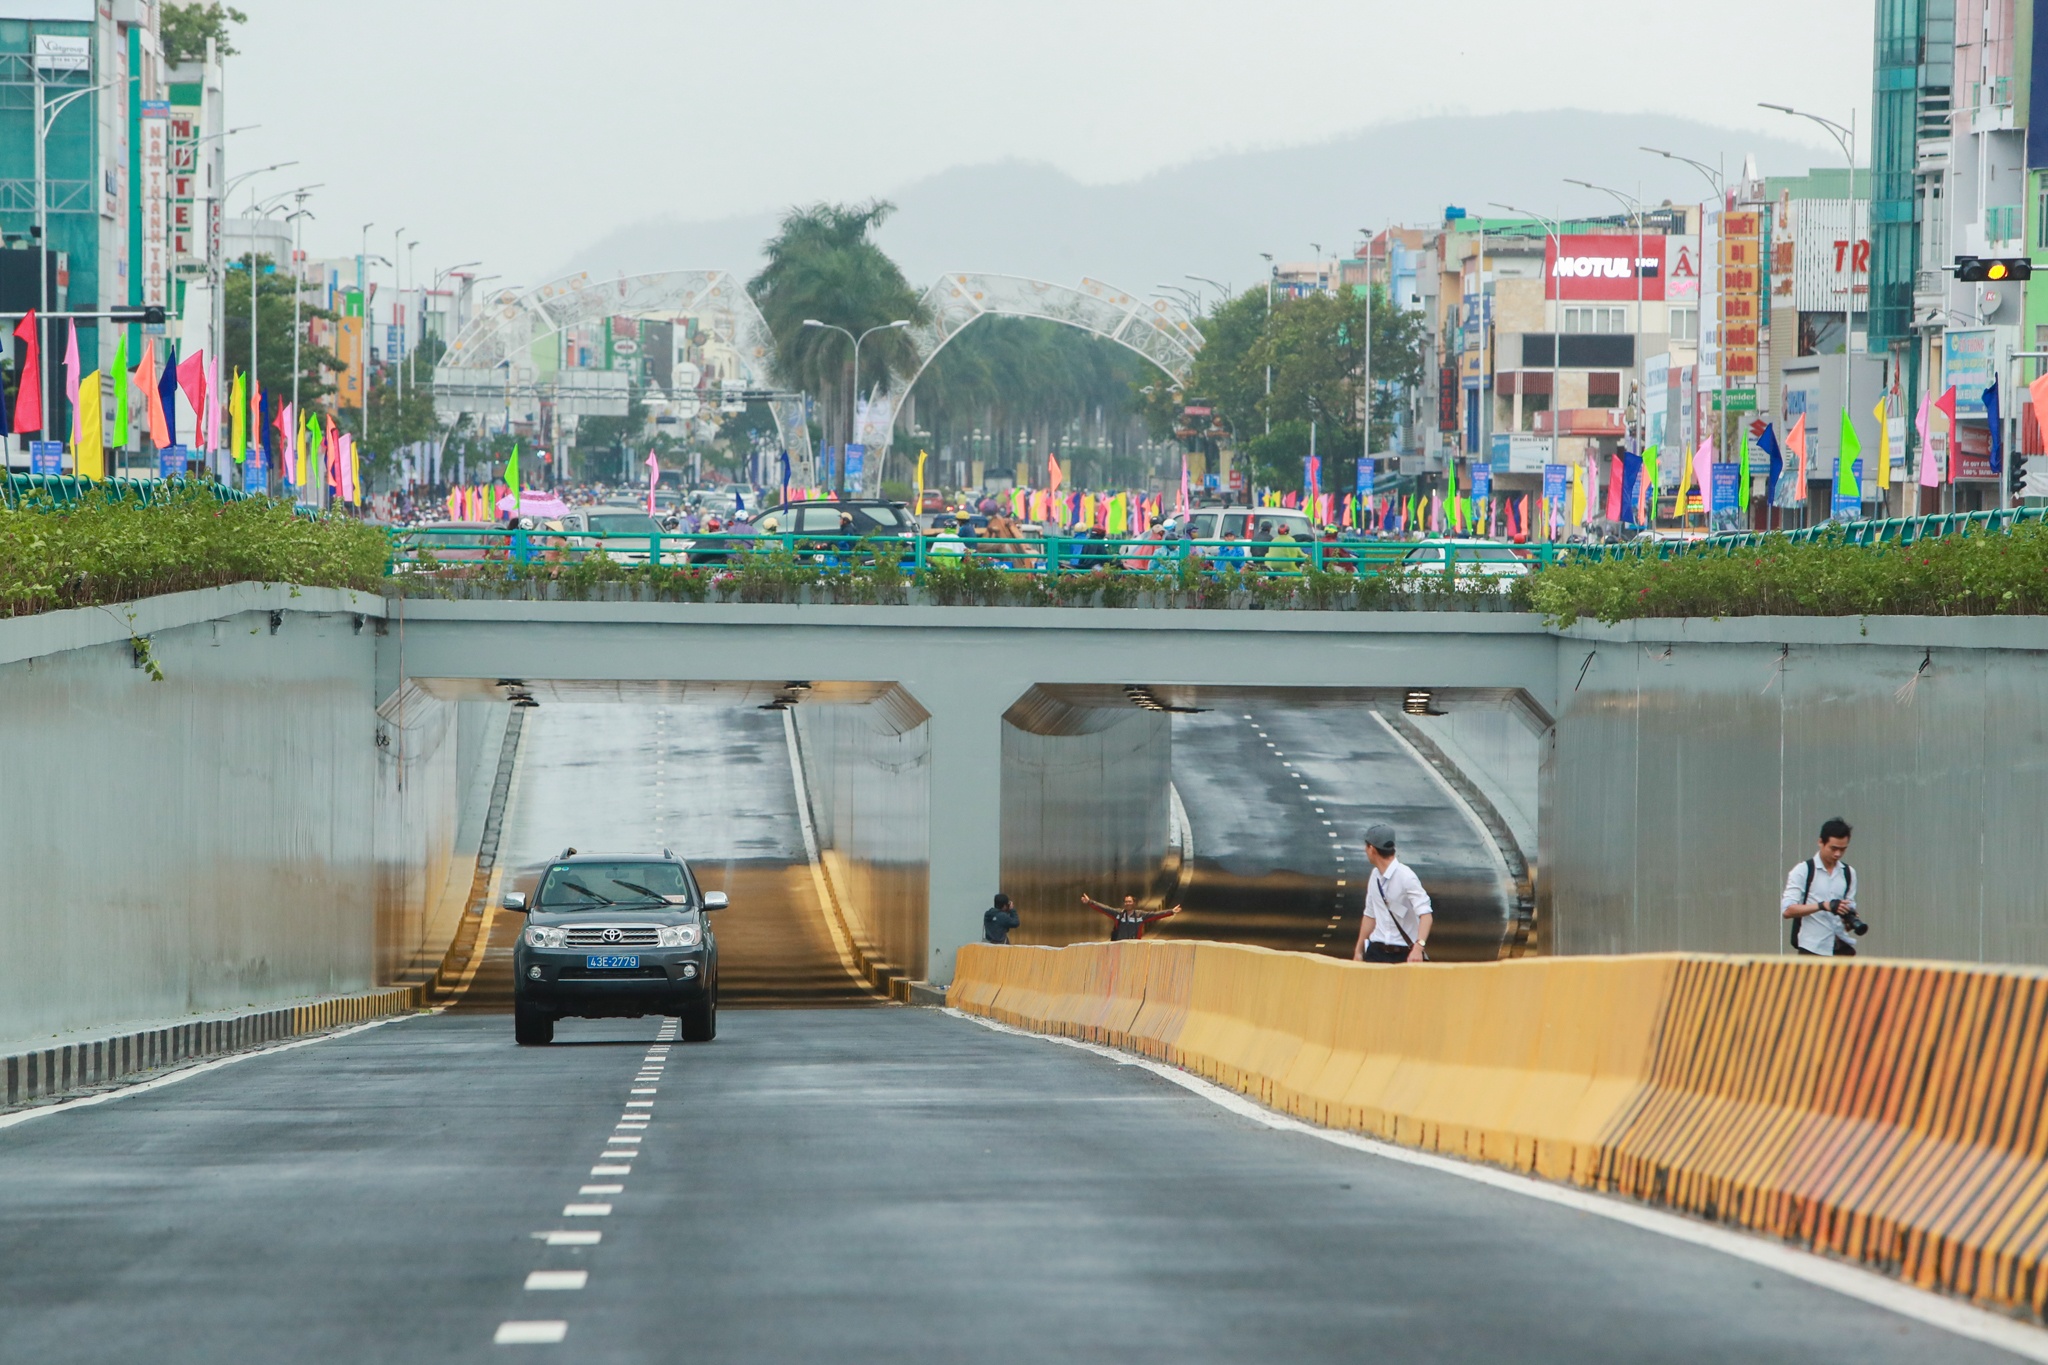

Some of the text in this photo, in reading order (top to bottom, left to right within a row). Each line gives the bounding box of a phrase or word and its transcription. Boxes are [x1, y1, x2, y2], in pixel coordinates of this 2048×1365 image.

[149, 126, 162, 167] NAM
[172, 120, 190, 253] HOTEL
[1552, 257, 1631, 278] MOTUL
[1731, 245, 1744, 263] BỊ
[150, 247, 161, 306] TRUN
[590, 957, 637, 967] 43E-2779
